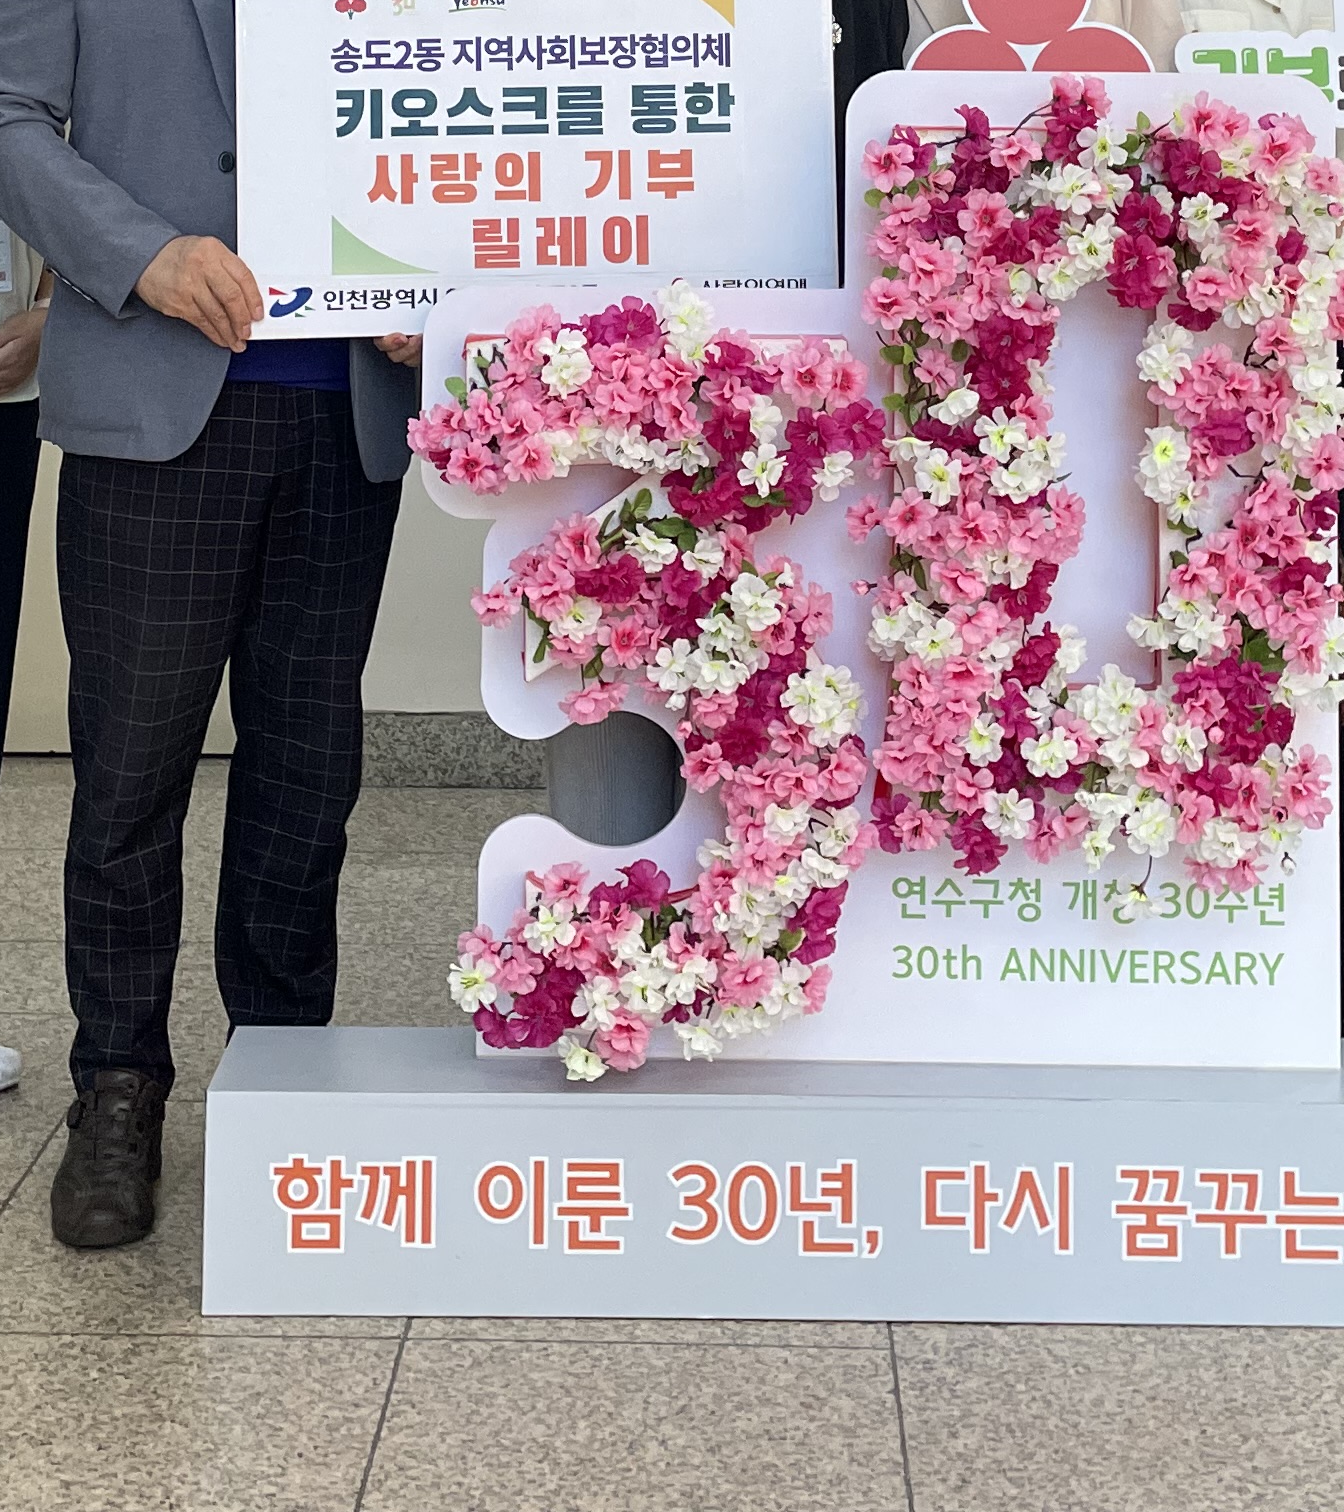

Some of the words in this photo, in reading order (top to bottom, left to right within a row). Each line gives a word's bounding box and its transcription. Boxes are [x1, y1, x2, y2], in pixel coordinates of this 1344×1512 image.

[331, 35, 445, 74] 송도2동
[452, 33, 731, 72] 지역사회보장협의체
[336, 85, 604, 138] 키오스크를
[631, 82, 735, 134] 통한
[368, 151, 541, 205] 사랑의
[584, 149, 695, 201] 기부
[472, 216, 649, 269] 릴레이
[323, 287, 438, 312] 인천광역시
[892, 875, 1041, 922] 연수구청
[1159, 882, 1285, 926] 30주년
[892, 944, 982, 980] 30th
[1000, 947, 1285, 986] ANNIVERSARY
[270, 1154, 437, 1252] 함께
[475, 1159, 631, 1254] 이룬
[668, 1160, 883, 1260] 30년,
[921, 1166, 1073, 1256] 다시
